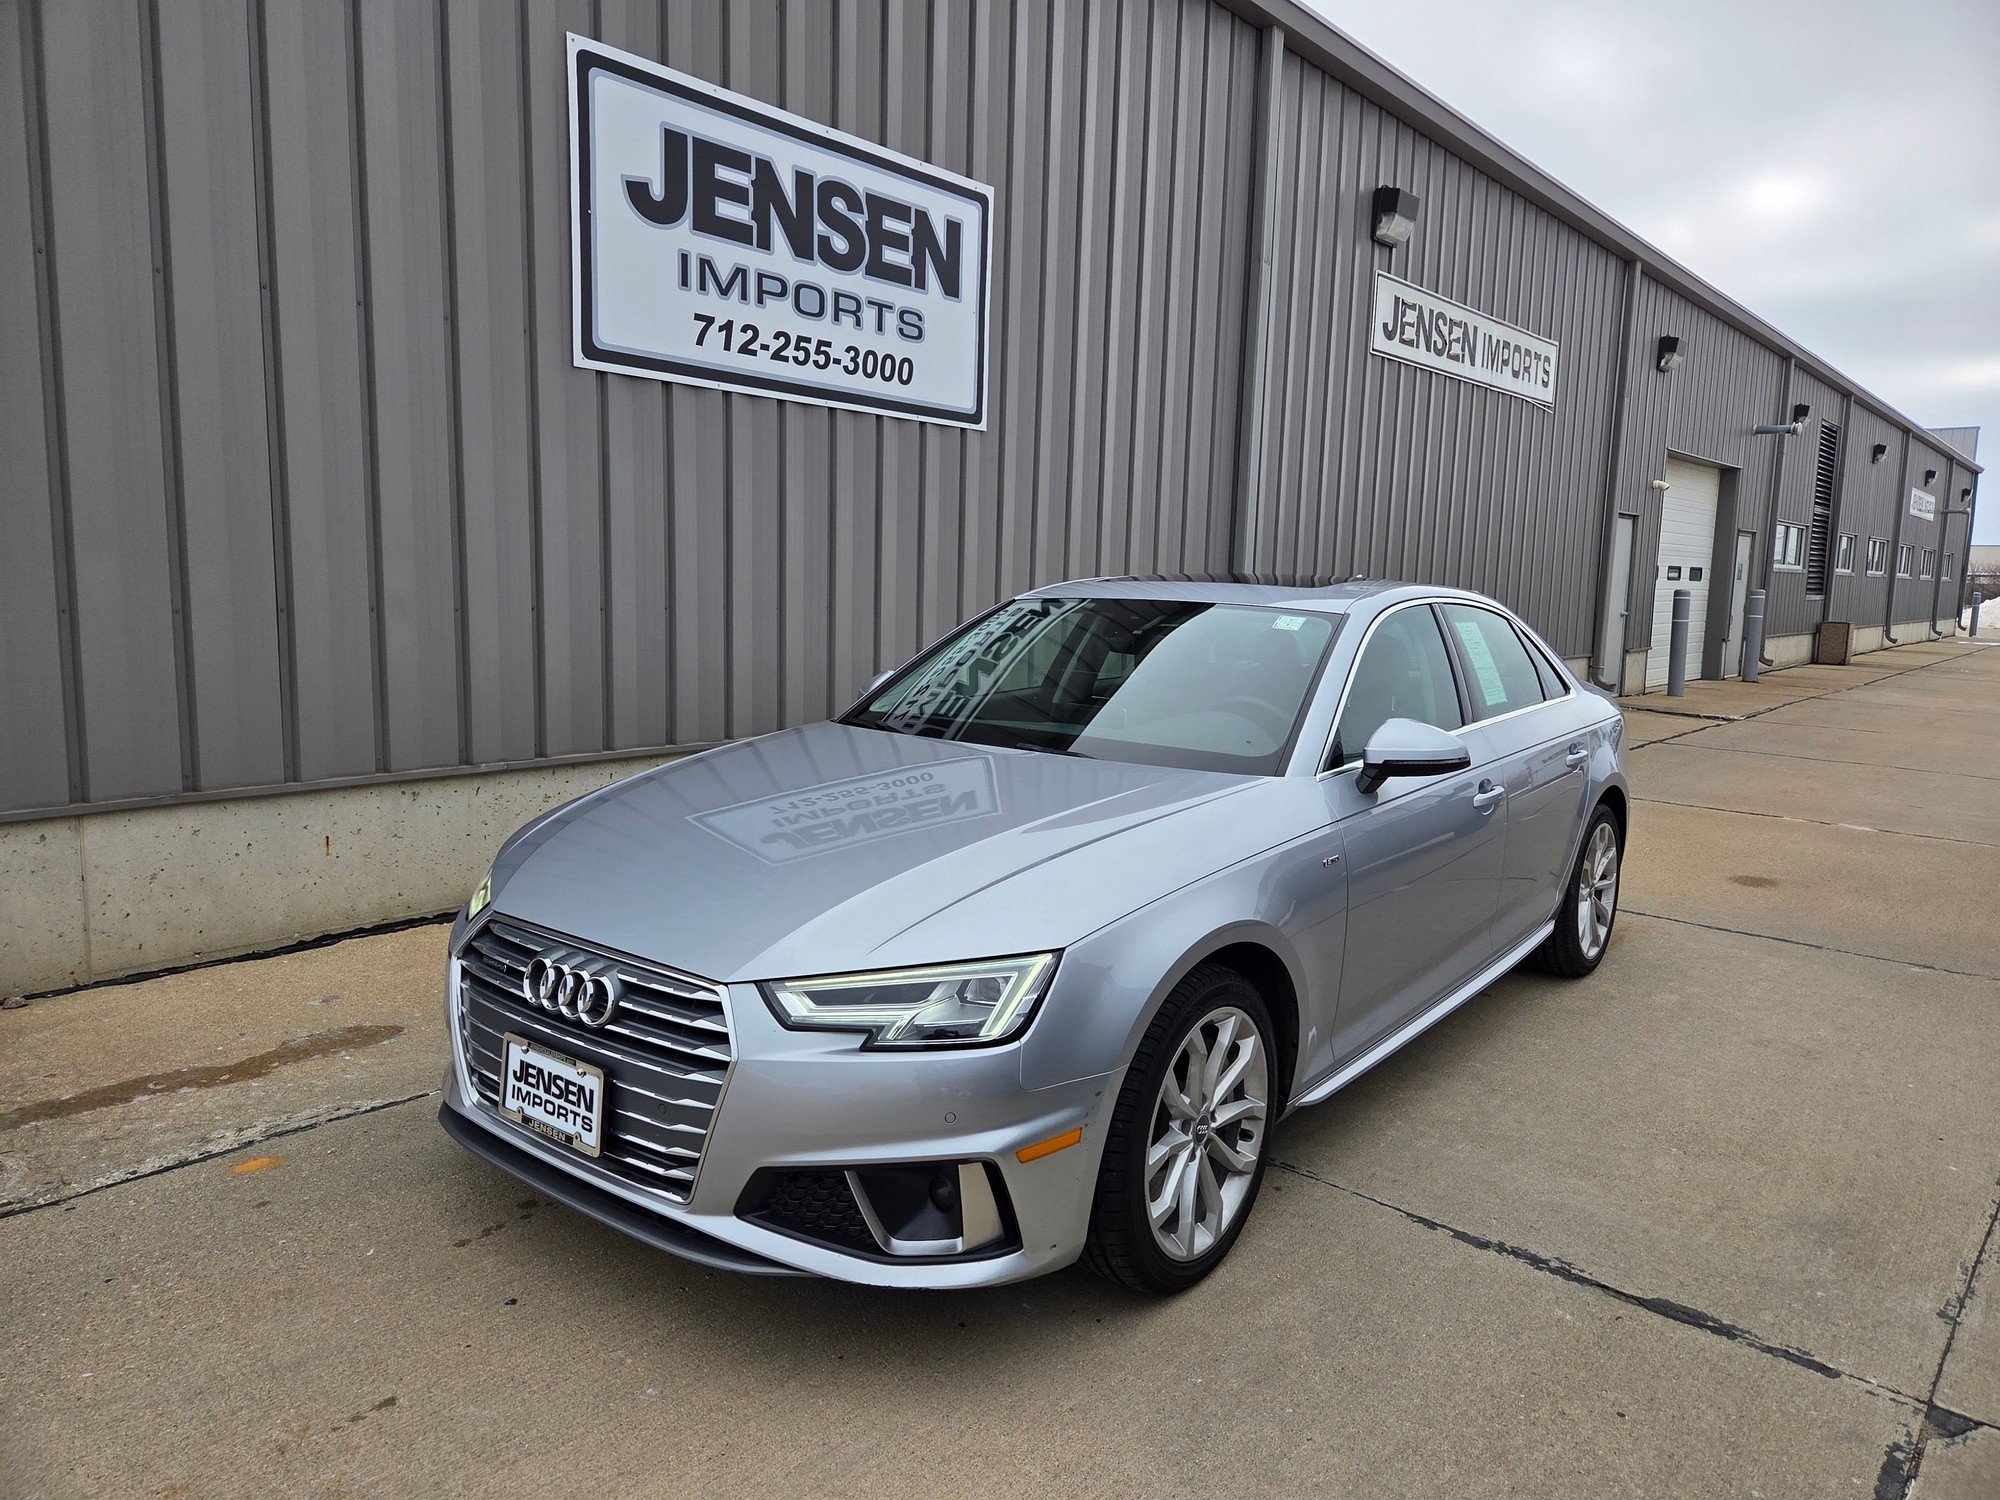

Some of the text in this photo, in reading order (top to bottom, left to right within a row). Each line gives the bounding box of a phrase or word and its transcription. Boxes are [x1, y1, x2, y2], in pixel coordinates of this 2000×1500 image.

[623, 122, 963, 301] JENSEN
[679, 250, 925, 343] IMPORTS
[693, 312, 915, 386] 712-255-3000
[1382, 293, 1551, 389] JENSEN IMPORTS
[511, 1083, 594, 1134] IMPORTS
[513, 1059, 595, 1115] JENSEN
[528, 1118, 567, 1142] JENSEN
